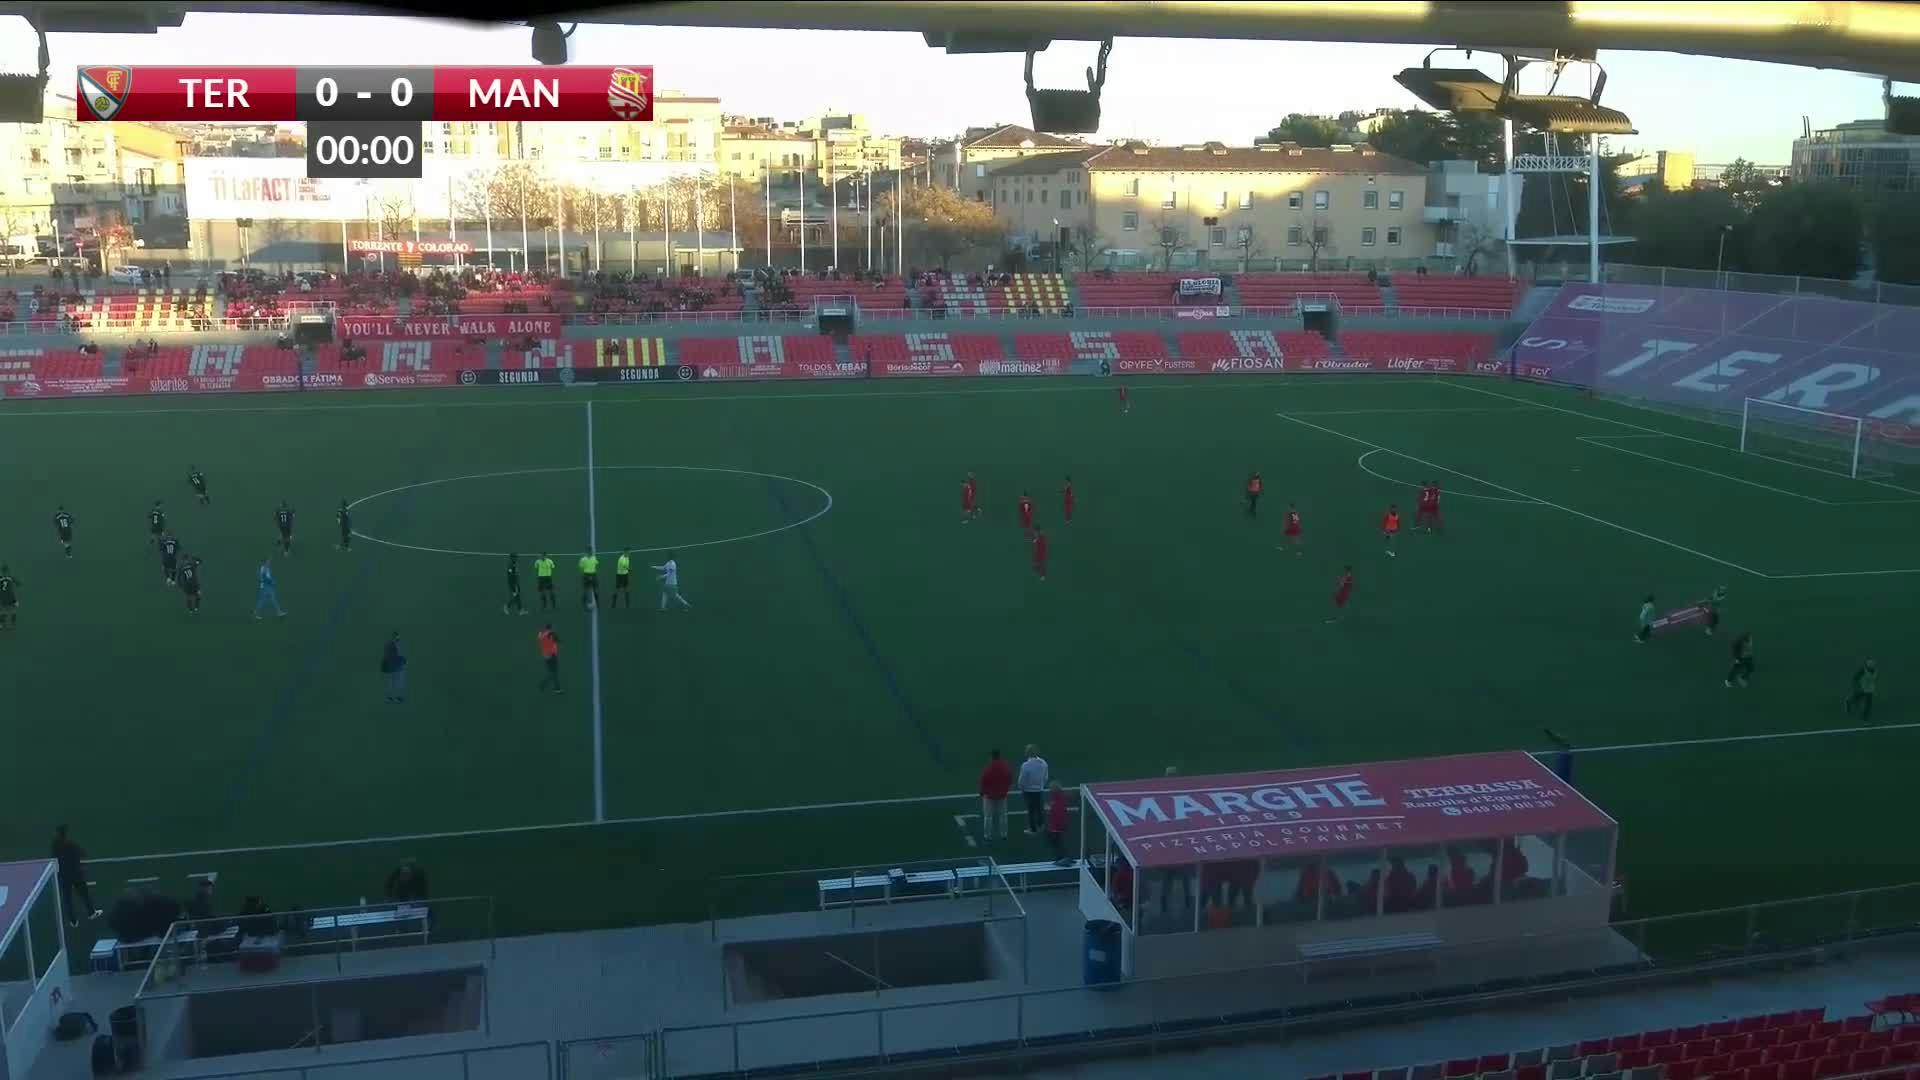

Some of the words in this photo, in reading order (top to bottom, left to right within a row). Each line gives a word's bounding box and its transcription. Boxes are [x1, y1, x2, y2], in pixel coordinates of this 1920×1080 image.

[404, 322, 450, 336] NEVER
[459, 322, 497, 335] WALK
[507, 320, 552, 334] ALONE
[1231, 358, 1284, 369] FIOSAN
[498, 371, 540, 384] SEGUNDA
[620, 368, 660, 381] SEGUNDA
[1103, 778, 1387, 827] MARGHE
[1402, 779, 1542, 799] TERRASSA
[1140, 829, 1264, 851] PIZZERIA
[1280, 821, 1407, 838] GOURMET
[1192, 832, 1368, 856] NAPOLETANA
